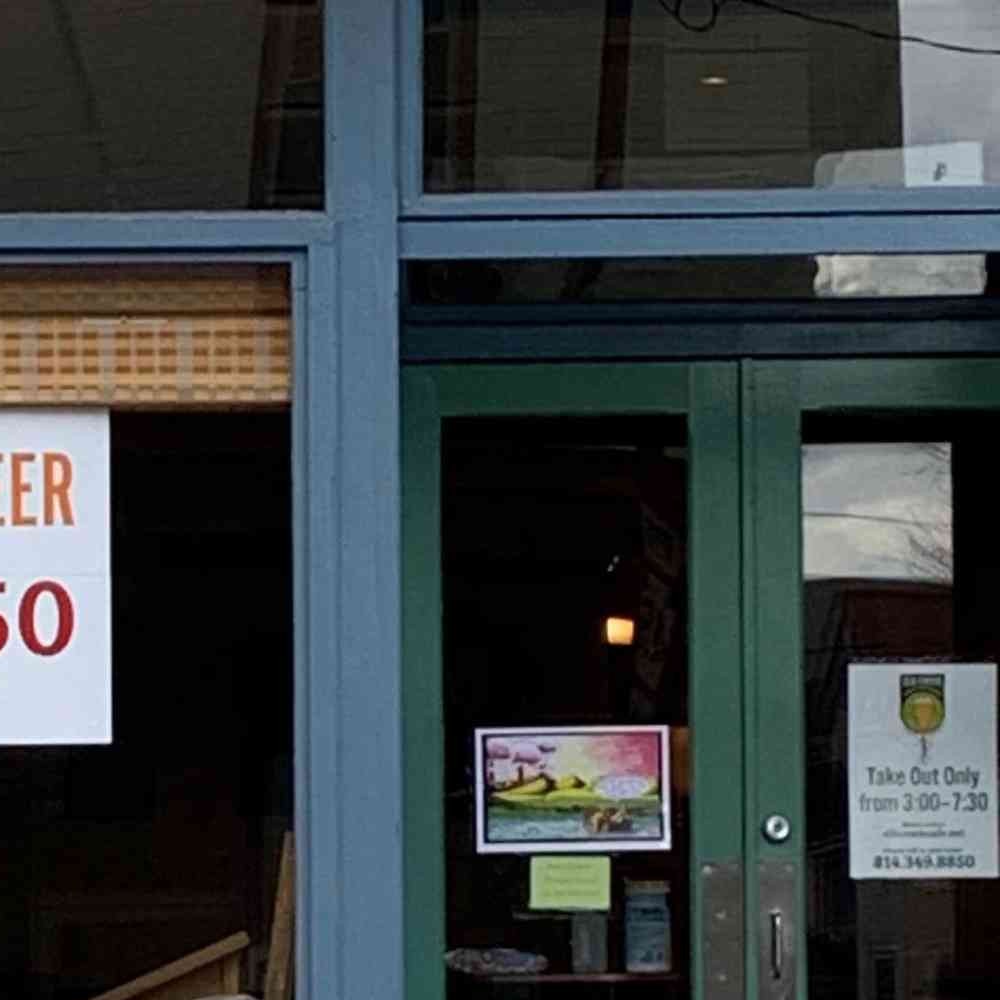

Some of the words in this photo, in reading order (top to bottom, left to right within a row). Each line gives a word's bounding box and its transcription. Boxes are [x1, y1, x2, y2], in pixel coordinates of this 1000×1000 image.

[866, 767, 905, 786] Take
[910, 767, 938, 786] Out
[944, 766, 980, 788] Only
[859, 792, 898, 812] from
